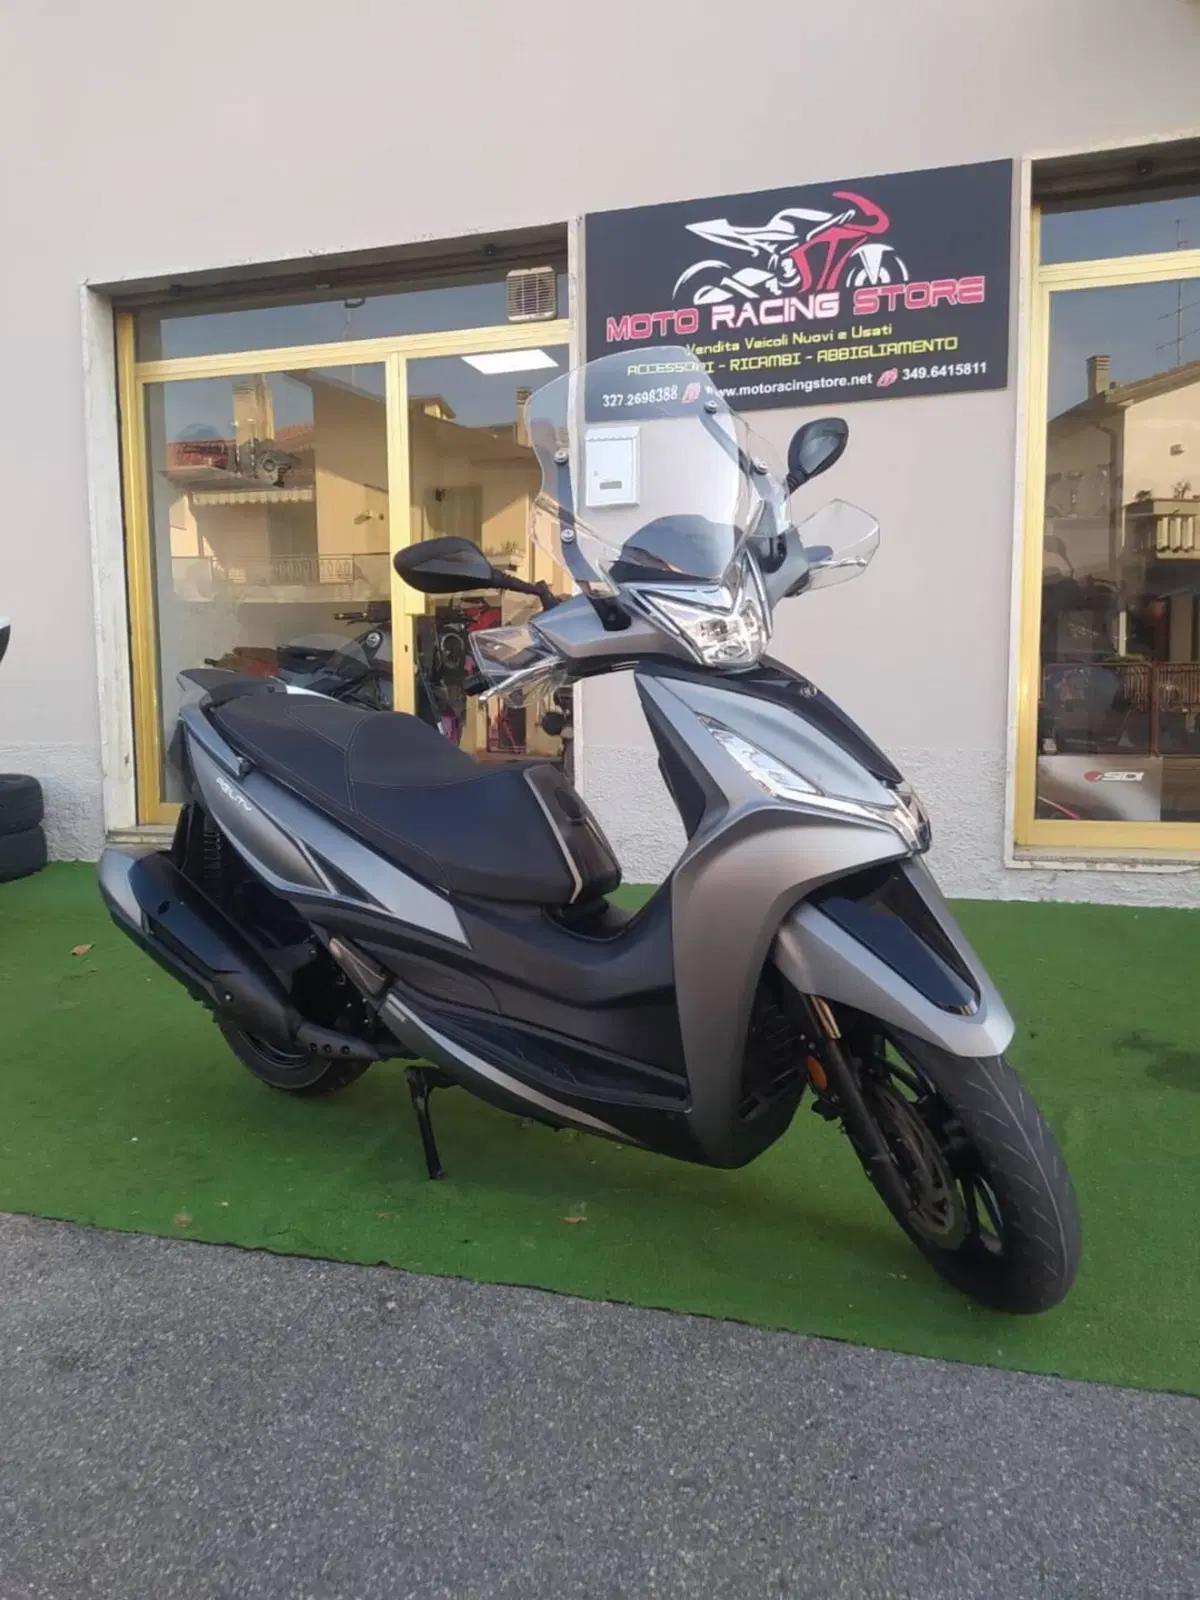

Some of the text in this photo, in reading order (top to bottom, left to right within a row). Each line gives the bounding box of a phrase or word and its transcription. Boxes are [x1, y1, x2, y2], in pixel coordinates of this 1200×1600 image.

[606, 275, 986, 342] MOTO RACING STORE
[686, 323, 893, 357] Vendita Veicoli Nuovi e Usati
[729, 352, 801, 372] RICAMBI
[817, 336, 959, 363] ABBIGLIAMENTO
[602, 384, 679, 408] 327.2698388
[902, 361, 988, 381] 349.6415811
